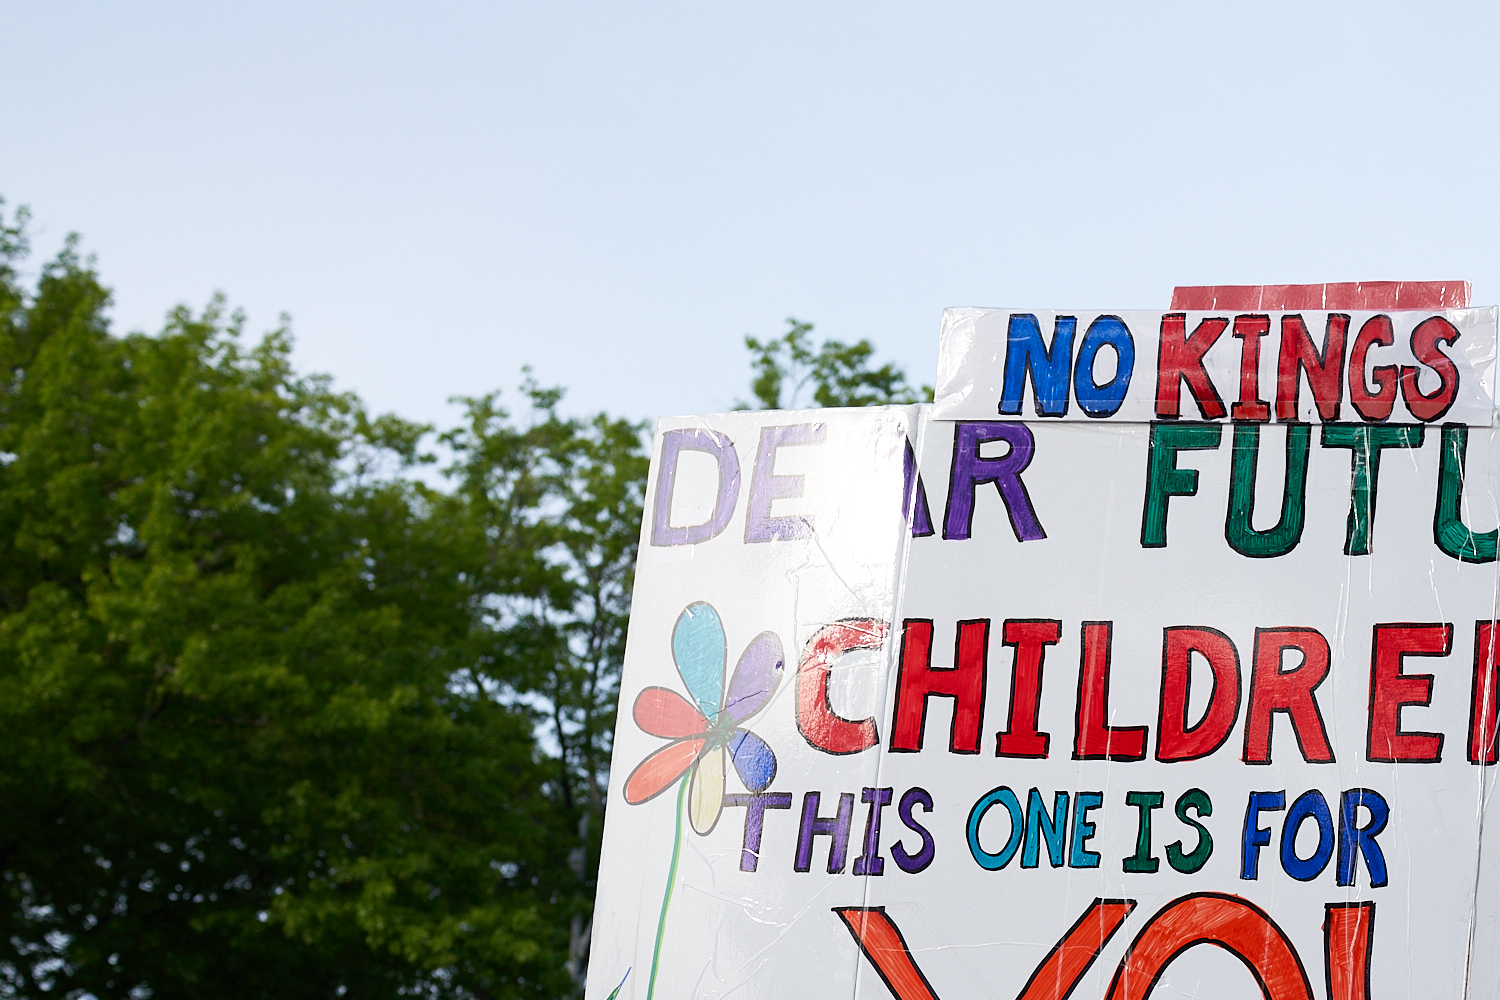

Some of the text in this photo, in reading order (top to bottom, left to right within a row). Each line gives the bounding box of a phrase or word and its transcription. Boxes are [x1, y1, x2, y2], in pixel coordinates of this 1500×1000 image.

[998, 313, 1461, 422] NO KINGS
[723, 786, 1391, 888] THIS ONE IS FOR
